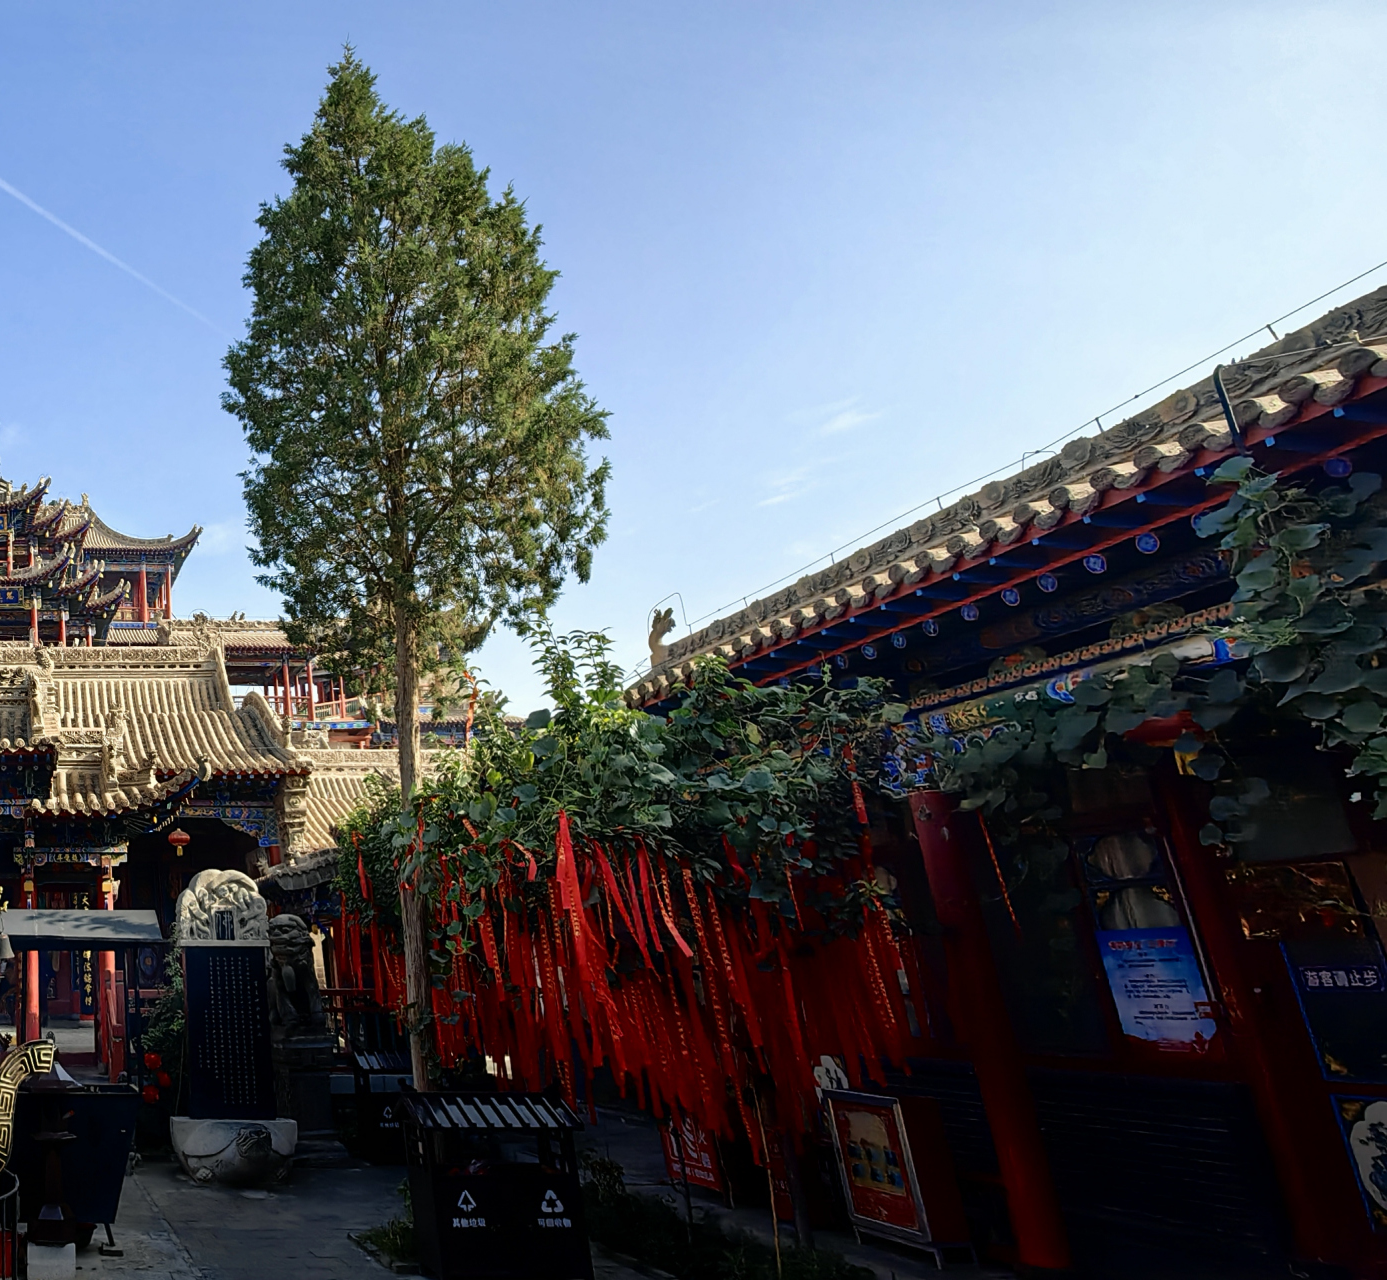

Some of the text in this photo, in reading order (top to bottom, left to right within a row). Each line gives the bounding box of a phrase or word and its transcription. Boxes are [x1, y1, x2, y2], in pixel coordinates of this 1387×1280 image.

[452, 1217, 486, 1228] 其他垃圾
[537, 1217, 572, 1228] 可回收物
